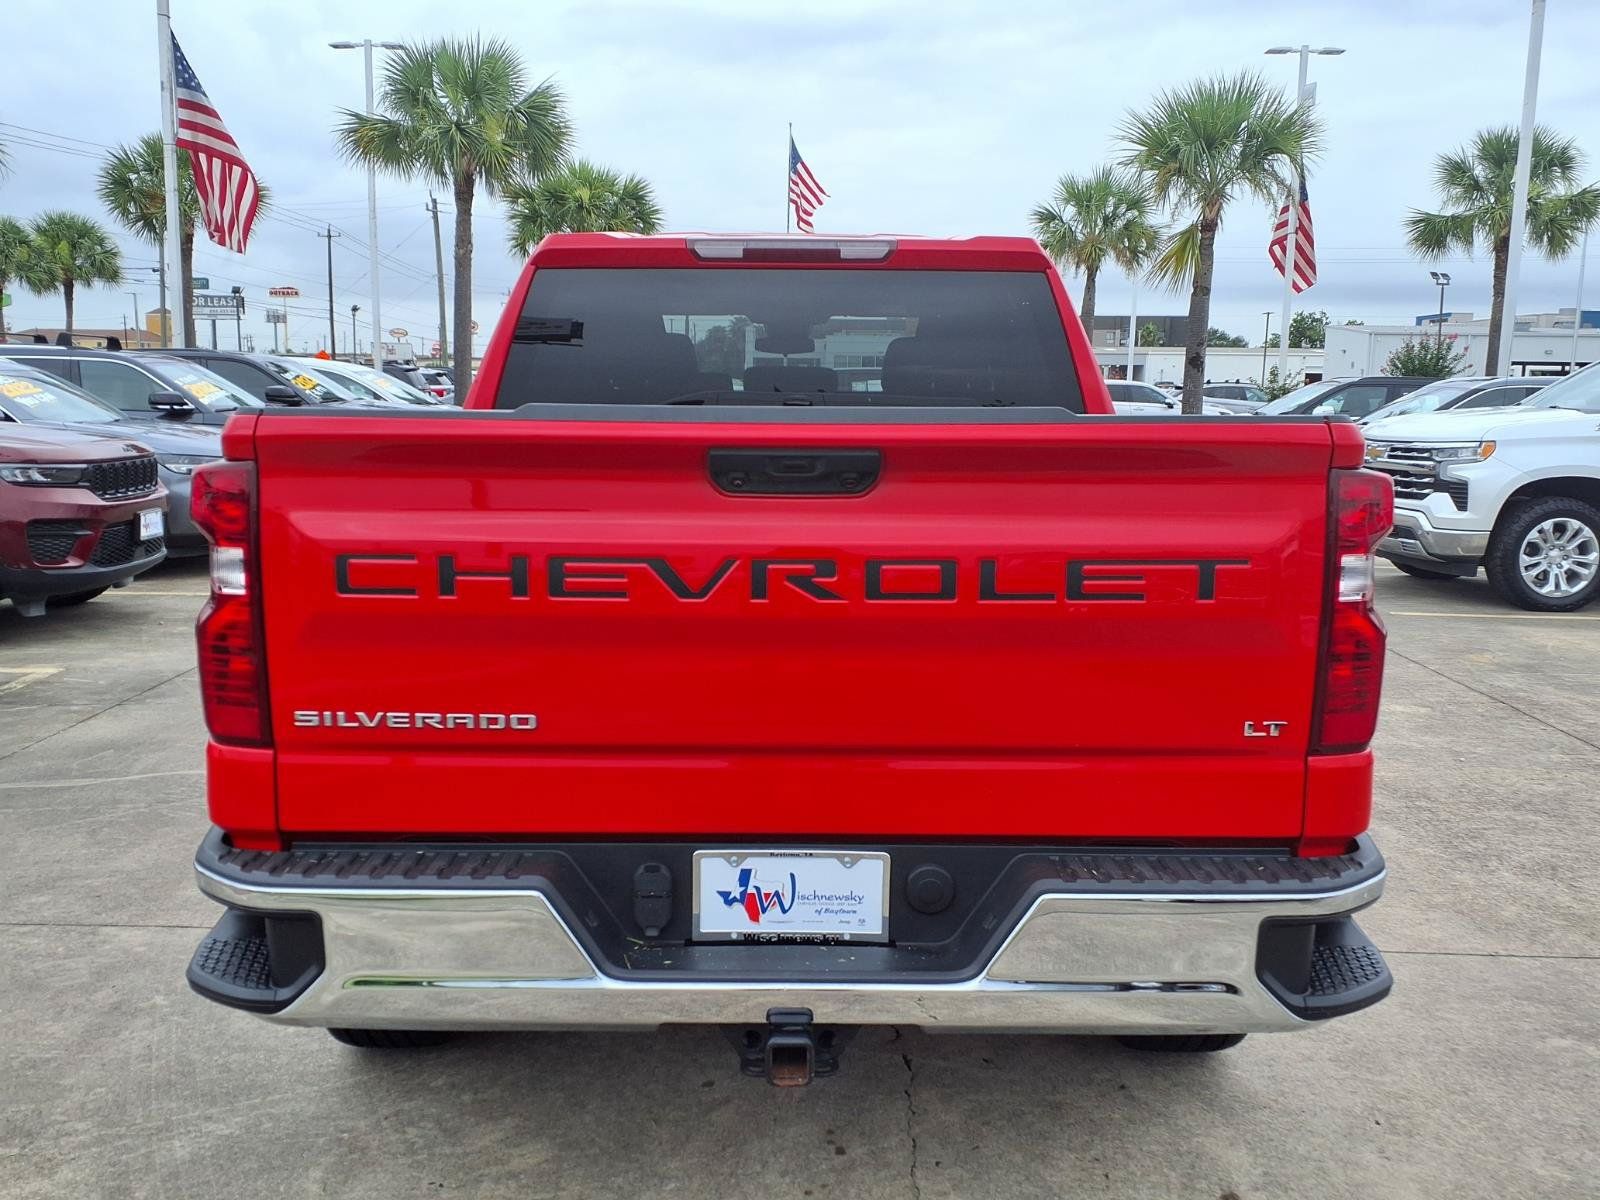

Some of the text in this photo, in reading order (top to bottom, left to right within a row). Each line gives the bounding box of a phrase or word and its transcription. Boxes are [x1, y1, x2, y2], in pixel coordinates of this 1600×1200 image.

[192, 297, 206, 306] OR
[336, 554, 1250, 604] CHEVROLET
[293, 710, 538, 730] SILVERADO
[1244, 721, 1288, 737] LT
